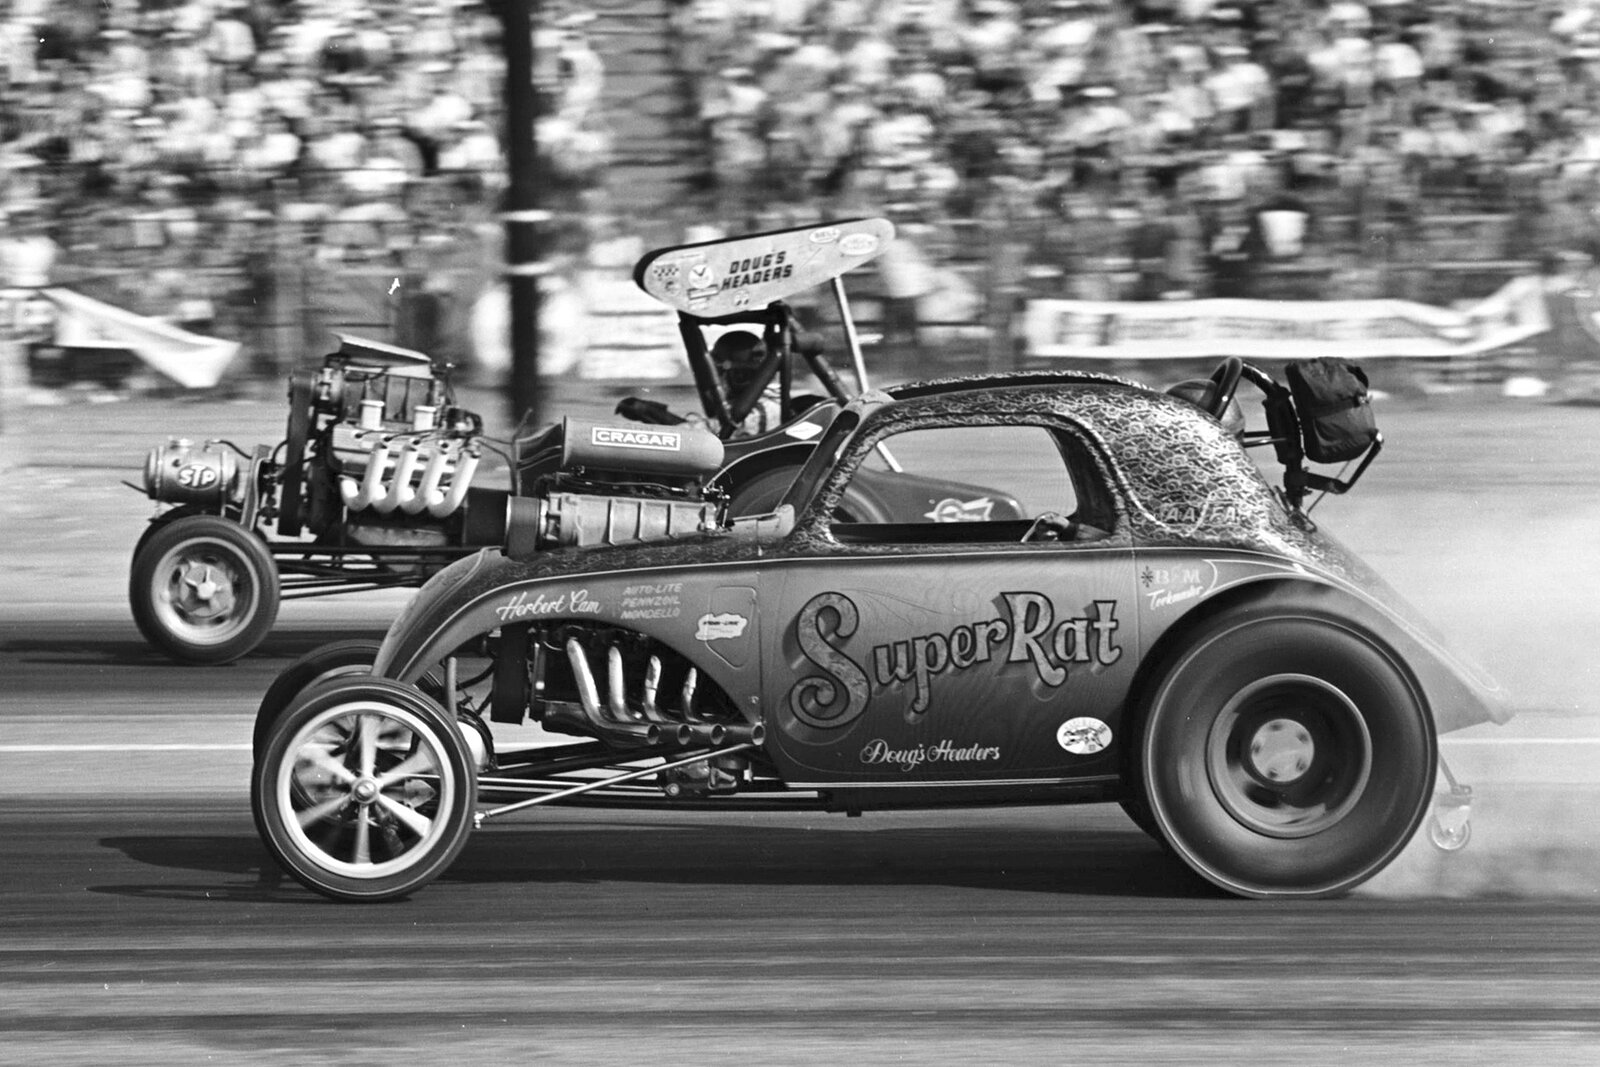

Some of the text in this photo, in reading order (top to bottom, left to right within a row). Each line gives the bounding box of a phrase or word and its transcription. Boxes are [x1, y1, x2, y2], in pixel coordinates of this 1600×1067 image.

[730, 250, 786, 274] DOUG'S
[721, 264, 793, 291] HEADERS
[596, 431, 677, 447] CRAGAR
[179, 465, 216, 487] STP
[622, 583, 683, 596] AUTO-LITE
[496, 589, 603, 621] Herbert Cam
[860, 738, 1000, 773] Doug's Headers
